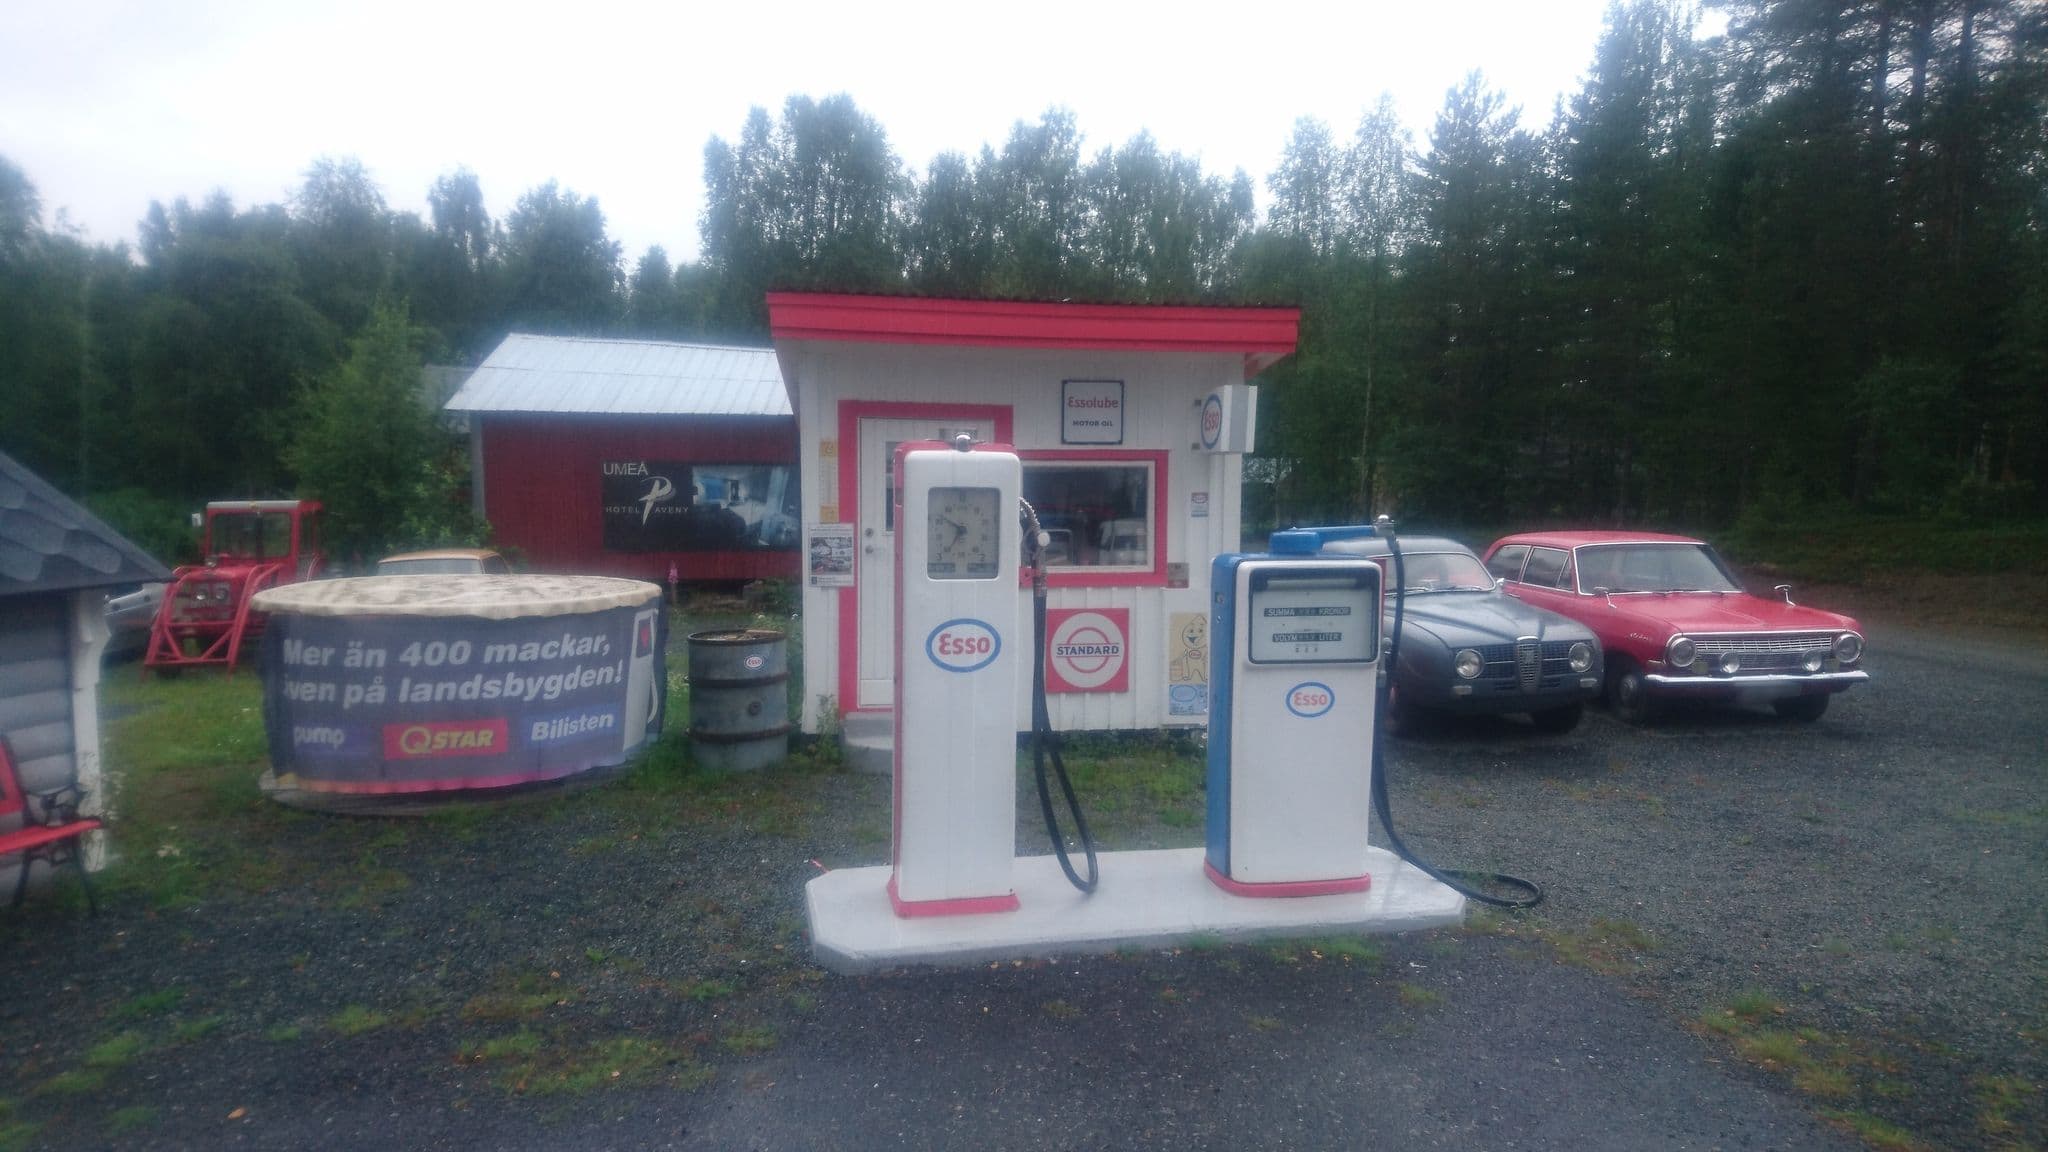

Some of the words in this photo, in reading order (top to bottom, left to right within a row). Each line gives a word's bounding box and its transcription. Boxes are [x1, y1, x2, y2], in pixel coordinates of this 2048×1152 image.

[1068, 396, 1119, 409] Essolube
[283, 639, 336, 666] Mer
[343, 641, 387, 668] än
[399, 640, 472, 667] 400
[483, 633, 611, 664] mackar,
[1056, 645, 1120, 656] STANDARD
[343, 676, 386, 710] på
[398, 659, 624, 704] landsbygden!
[531, 712, 614, 741] Bilisten
